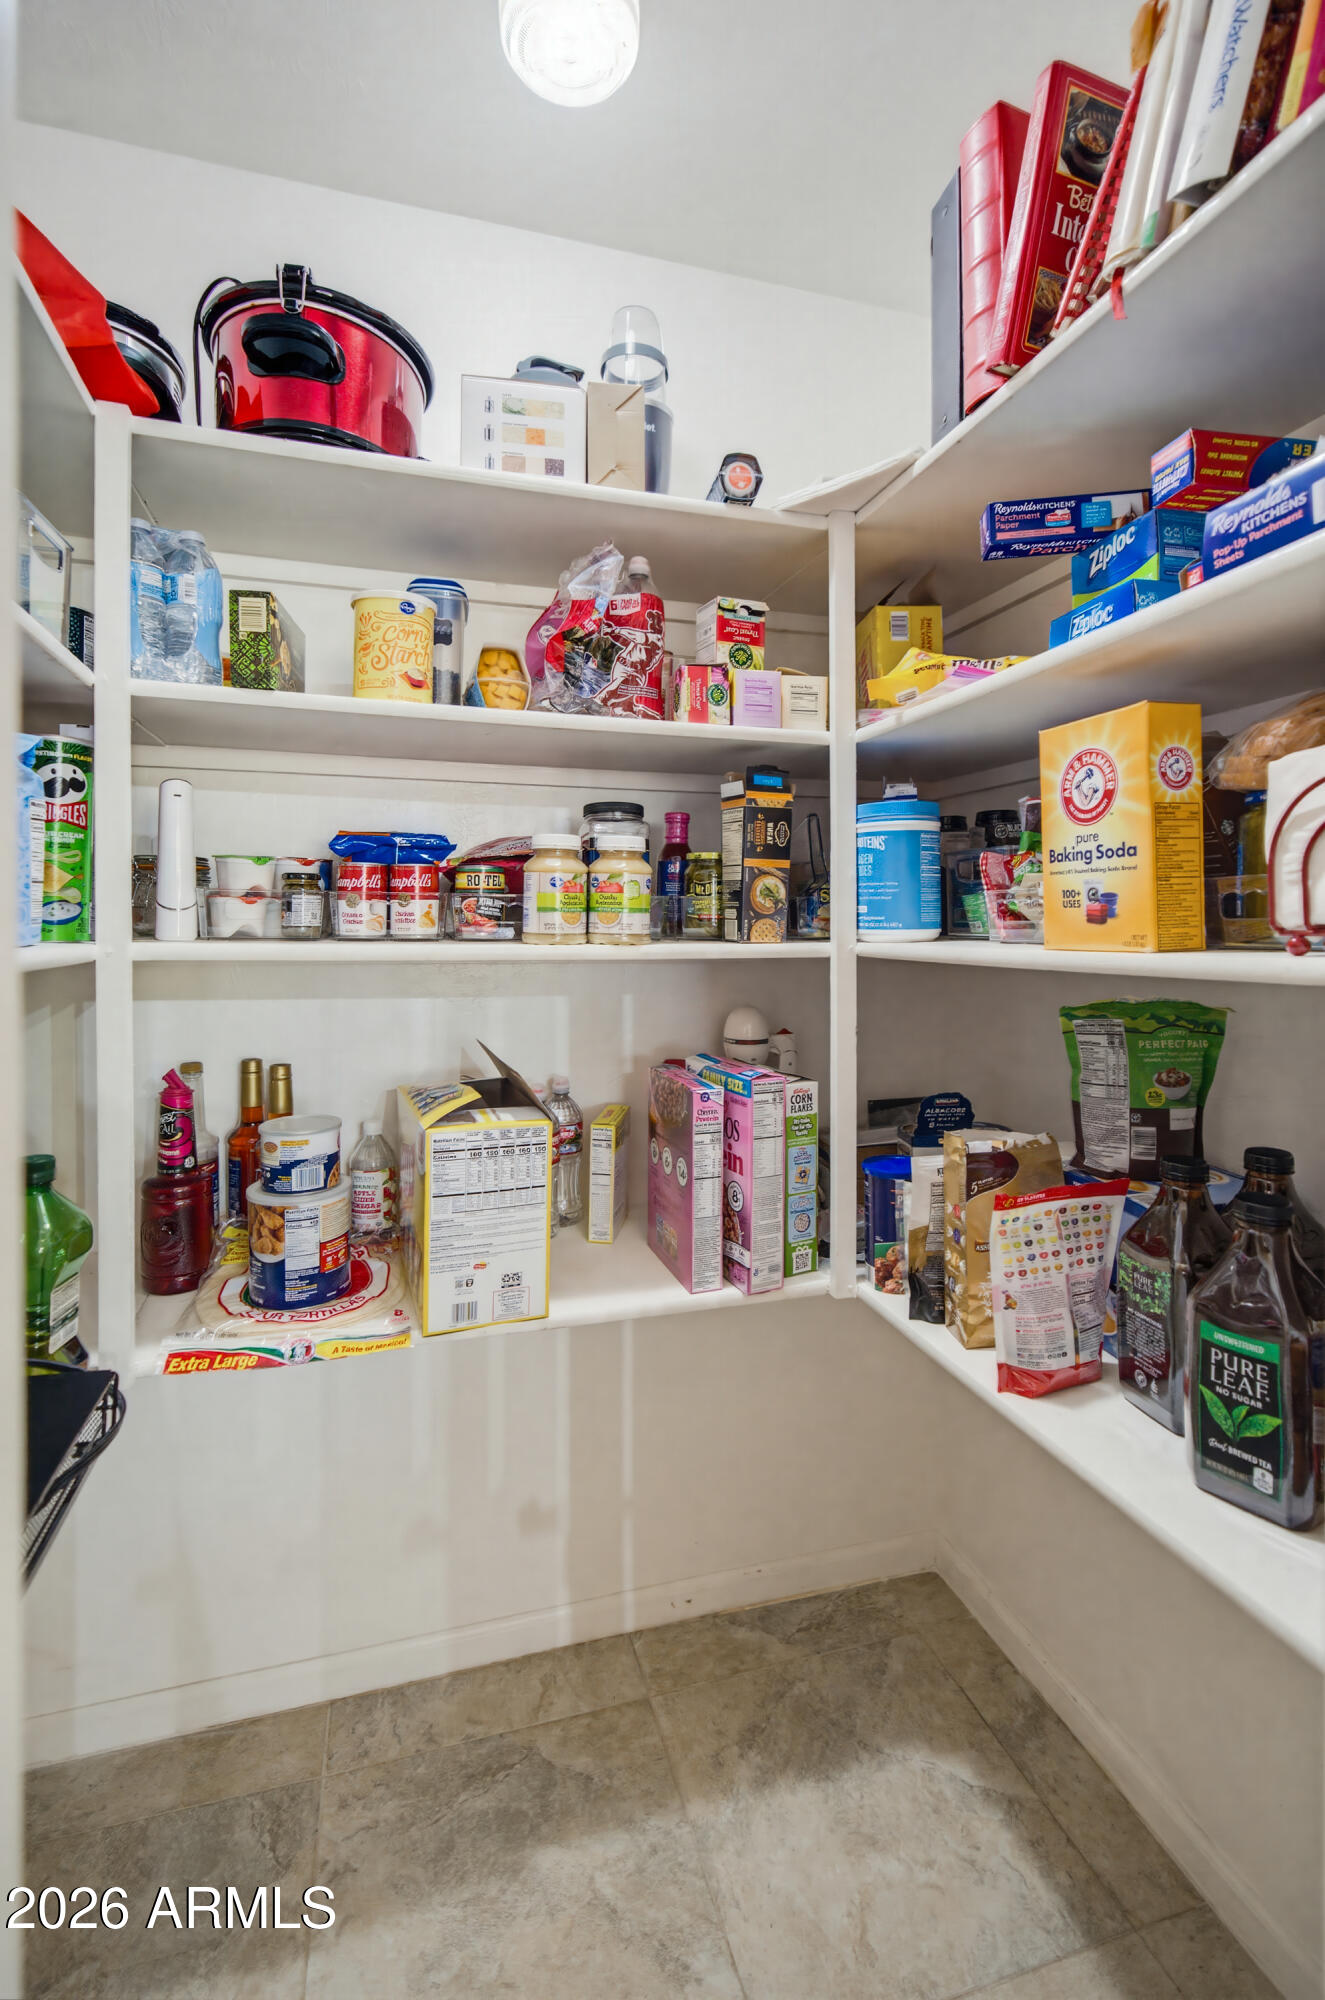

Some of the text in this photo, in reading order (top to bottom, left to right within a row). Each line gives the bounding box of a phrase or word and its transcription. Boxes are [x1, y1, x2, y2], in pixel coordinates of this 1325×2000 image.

[994, 500, 1076, 515] Reynolds KITCHENS
[995, 512, 1040, 521] Parchment
[1211, 482, 1292, 537] Reynolds
[1241, 490, 1308, 534] KITCHENS
[996, 522, 1020, 530] Paper
[1213, 537, 1248, 560] Pop-Up
[1248, 510, 1304, 542] Parchment
[1089, 526, 1136, 578] Ziploc
[1214, 550, 1244, 570] Sheets
[1071, 604, 1114, 638] Ziploc
[382, 623, 426, 643] Corn
[371, 642, 432, 672] Starch
[1063, 751, 1115, 798] ARM & HAMMER
[46, 804, 86, 826] INGLES
[858, 835, 886, 851] OTEINS
[1076, 832, 1099, 846] pure
[1050, 842, 1138, 865] Baking Soda
[338, 874, 382, 891] ampbell's
[390, 873, 432, 890] ampbell's
[1062, 890, 1082, 899] 100+
[1062, 900, 1082, 908] USES
[1138, 1040, 1185, 1049] PERFECT
[703, 1068, 748, 1094] FAMILY SIZE
[790, 1092, 813, 1105] CORN
[791, 1103, 814, 1114] FLAKES
[970, 1182, 978, 1195] 5
[332, 1346, 339, 1354] A
[342, 1345, 363, 1353] Taste
[1213, 1330, 1265, 1354] UNSWEETENED
[167, 1354, 259, 1373] Extra Large
[1210, 1347, 1269, 1384] PURE
[1210, 1364, 1270, 1400] LEAF
[1216, 1386, 1264, 1410] NO SUGAR
[1228, 1444, 1258, 1464] BREWED
[1258, 1458, 1272, 1472] TEA
